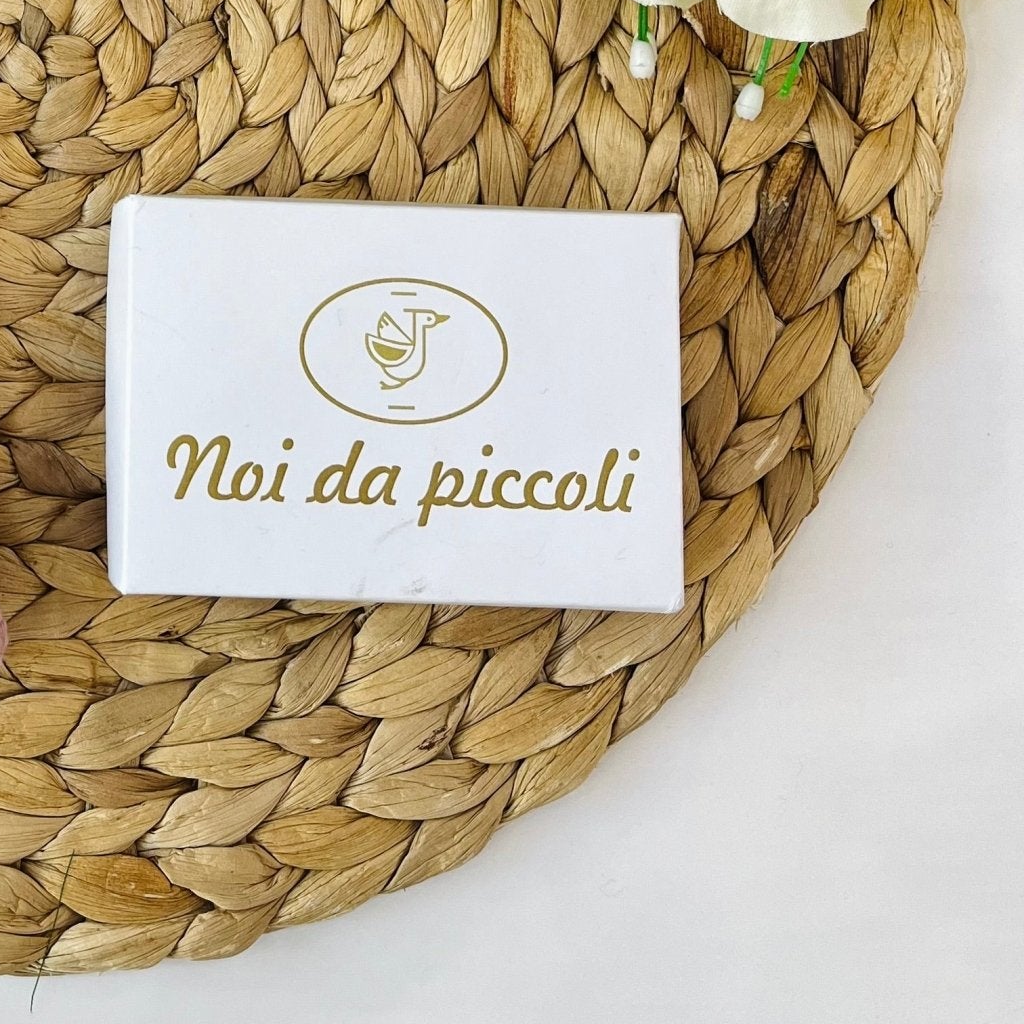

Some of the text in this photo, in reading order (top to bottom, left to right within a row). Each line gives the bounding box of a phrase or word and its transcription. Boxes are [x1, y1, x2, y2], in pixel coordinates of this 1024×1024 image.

[166, 434, 641, 527] Noi da piccoli
